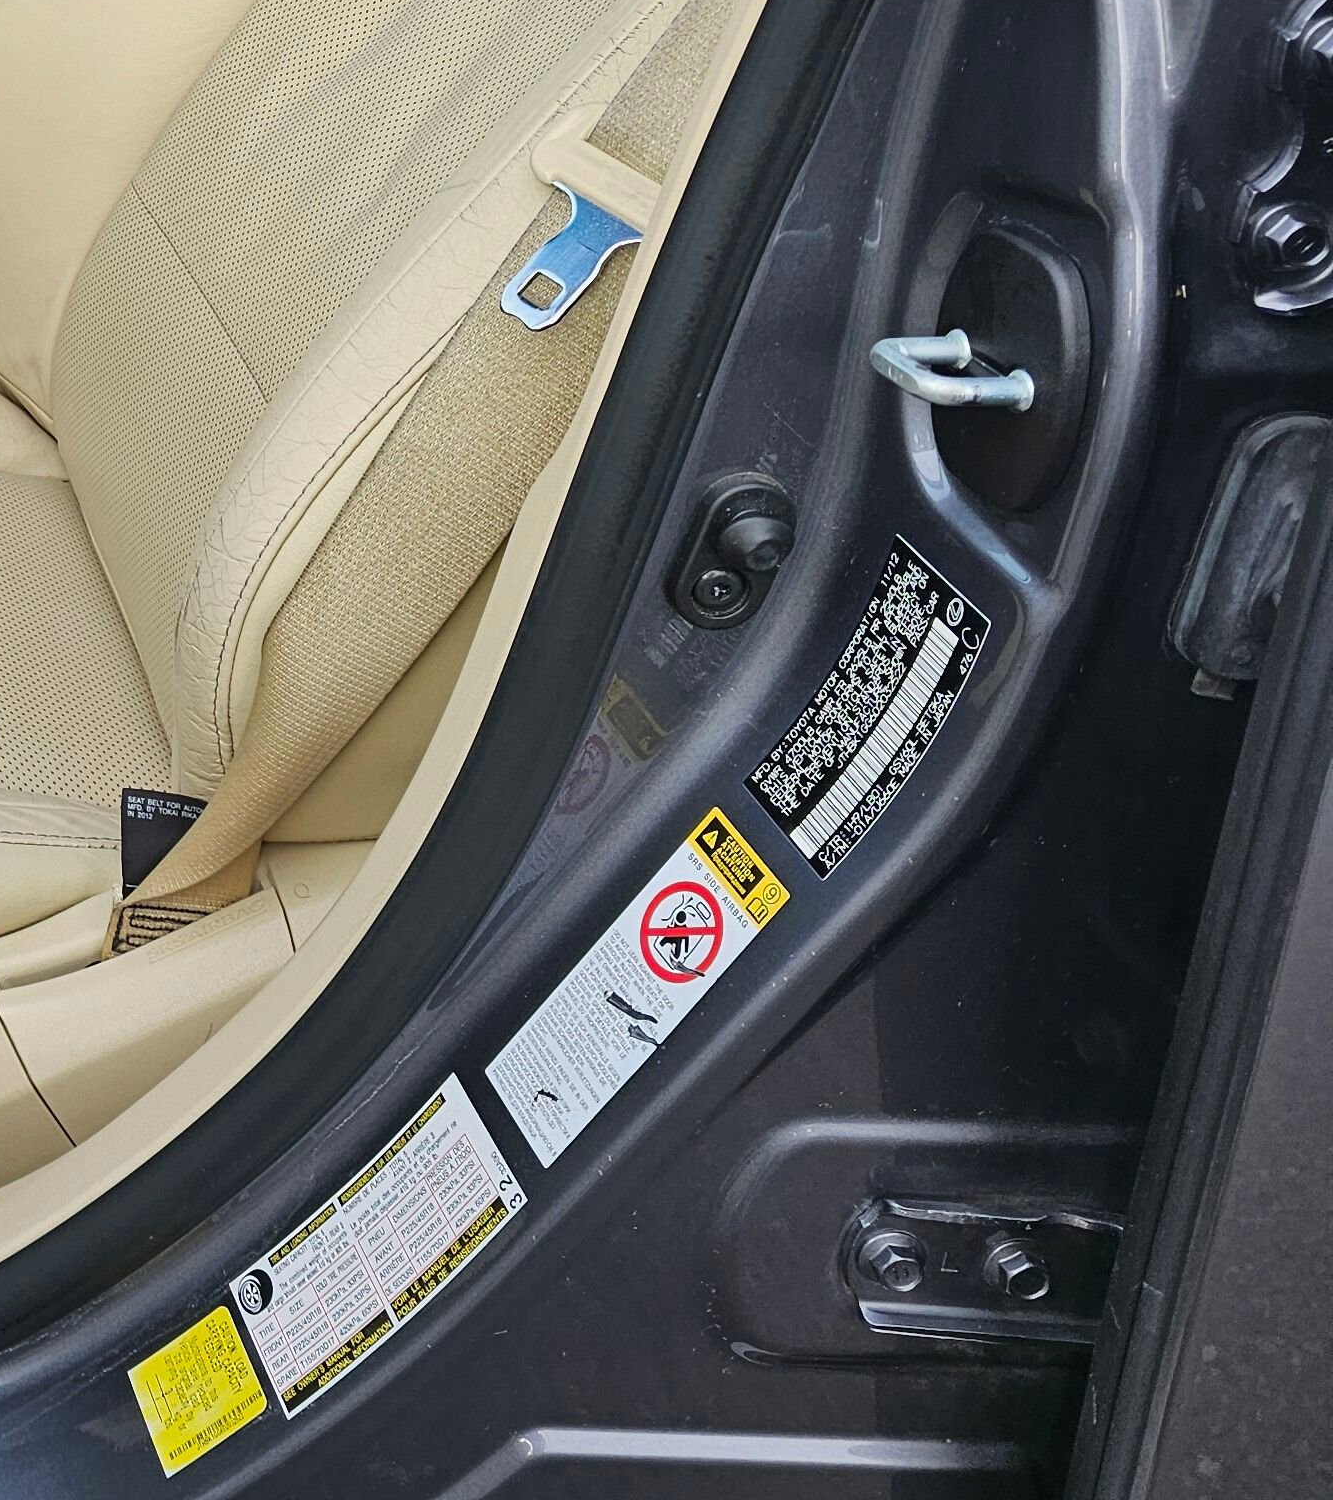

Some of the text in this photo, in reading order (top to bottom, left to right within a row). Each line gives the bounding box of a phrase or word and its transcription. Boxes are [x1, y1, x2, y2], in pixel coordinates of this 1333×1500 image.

[813, 669, 840, 706] MOTOR
[837, 595, 880, 670] CORPORATION
[880, 550, 900, 588] 11/12
[925, 589, 940, 616] CAR
[764, 558, 916, 796] THIS VEHICLE CONFORMS TO ALL APPLICABLE
[769, 762, 807, 806] FEDERAL
[807, 725, 835, 762] MOTOR
[833, 677, 868, 726] VEHICLE
[908, 565, 924, 591] AND
[777, 570, 930, 811] THEFT PREVENTION STANDARDS IN EFFECT ON
[956, 649, 973, 676] 476
[758, 763, 783, 792] GVWR
[782, 724, 815, 765] 4700LB
[813, 695, 836, 725] GAWR
[832, 677, 847, 696] FR
[845, 636, 873, 678] 2625LB
[781, 796, 801, 817] THE
[800, 768, 825, 797] DATE
[823, 751, 837, 768] OF
[836, 680, 886, 752] MANUFACTURE
[884, 641, 907, 680] SHOWN
[897, 746, 920, 778] MADE
[919, 727, 932, 744] IN
[929, 688, 954, 728] JAPAN
[127, 795, 145, 804] SEAT
[147, 798, 164, 807] BELT
[165, 801, 181, 810] FOR
[137, 812, 153, 820] 2012
[146, 805, 155, 813] BY
[158, 807, 178, 816] TOKAI
[714, 845, 747, 883] ACHTUNG
[719, 839, 756, 882] ATTENTION
[724, 834, 754, 869] CAUTION
[686, 852, 703, 871] SRS
[702, 872, 721, 894] SIDE
[720, 895, 749, 929] AIRBAG
[765, 885, 779, 900] 9
[258, 1321, 275, 1339] TIRE
[287, 1297, 305, 1316] SIZE
[367, 1225, 386, 1247] PNEU
[391, 1184, 427, 1224] DIMENSIONS
[452, 1138, 464, 1156] DES
[391, 1205, 495, 1311] VOIR LE MANUEL DE L'USAGER
[395, 1206, 508, 1319] POUR PLUS DE RENSEIGNEMENTS
[261, 1334, 285, 1357] FRONT
[372, 1240, 396, 1264] AVANT
[275, 1365, 298, 1388] SPARE
[416, 1230, 451, 1267] T155/70D17
[233, 1357, 248, 1380] LOAD
[270, 1352, 290, 1371] REAR
[282, 1329, 365, 1402] SEE OWNER'S MANUAL FOR
[316, 1318, 392, 1388] ADDITIONAL INFORMATION
